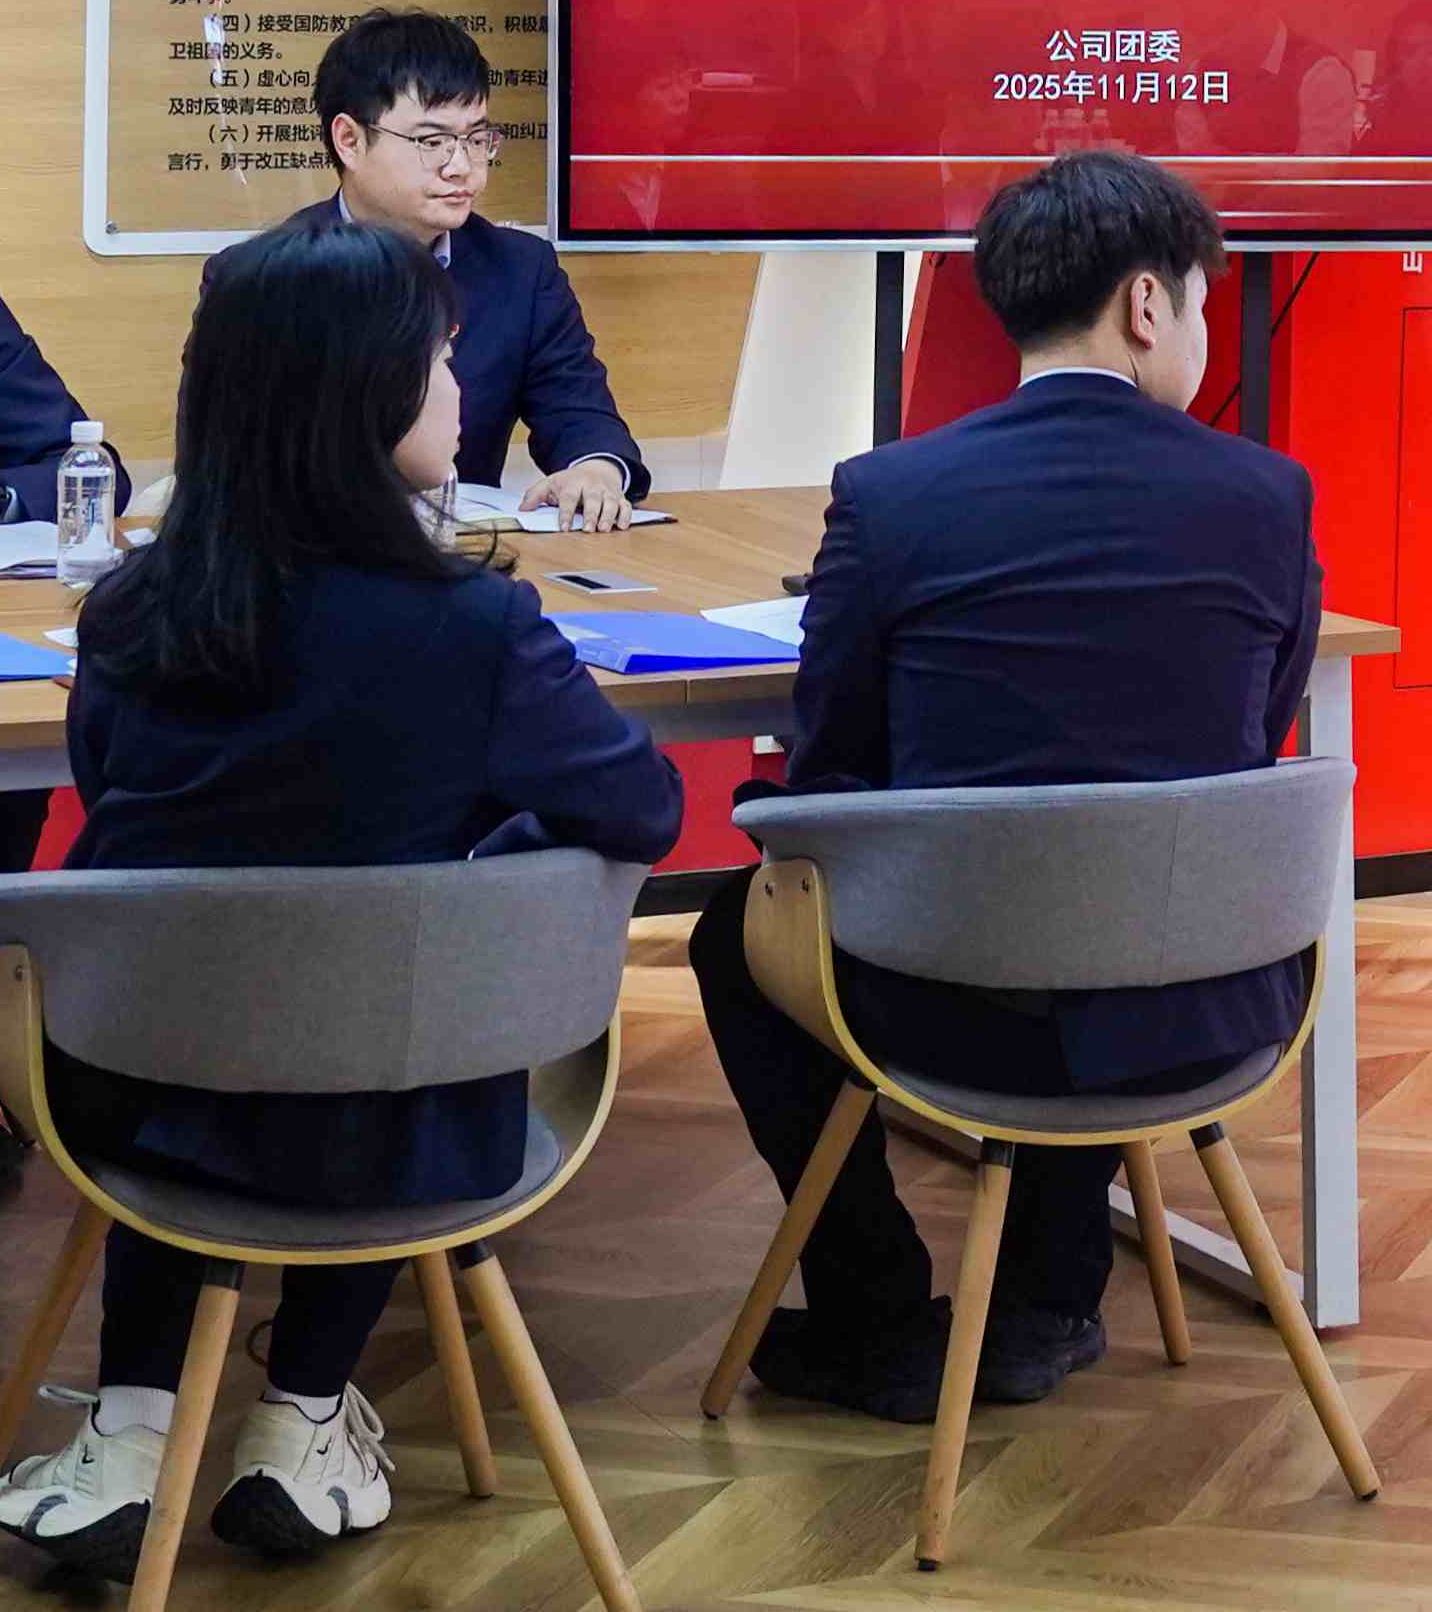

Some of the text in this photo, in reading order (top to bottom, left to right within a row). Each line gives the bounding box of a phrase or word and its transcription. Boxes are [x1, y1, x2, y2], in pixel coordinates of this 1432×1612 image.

[1047, 29, 1181, 64] 公司团委
[209, 69, 317, 89] （五）虚心向
[992, 70, 1231, 107] 2025年11月12日
